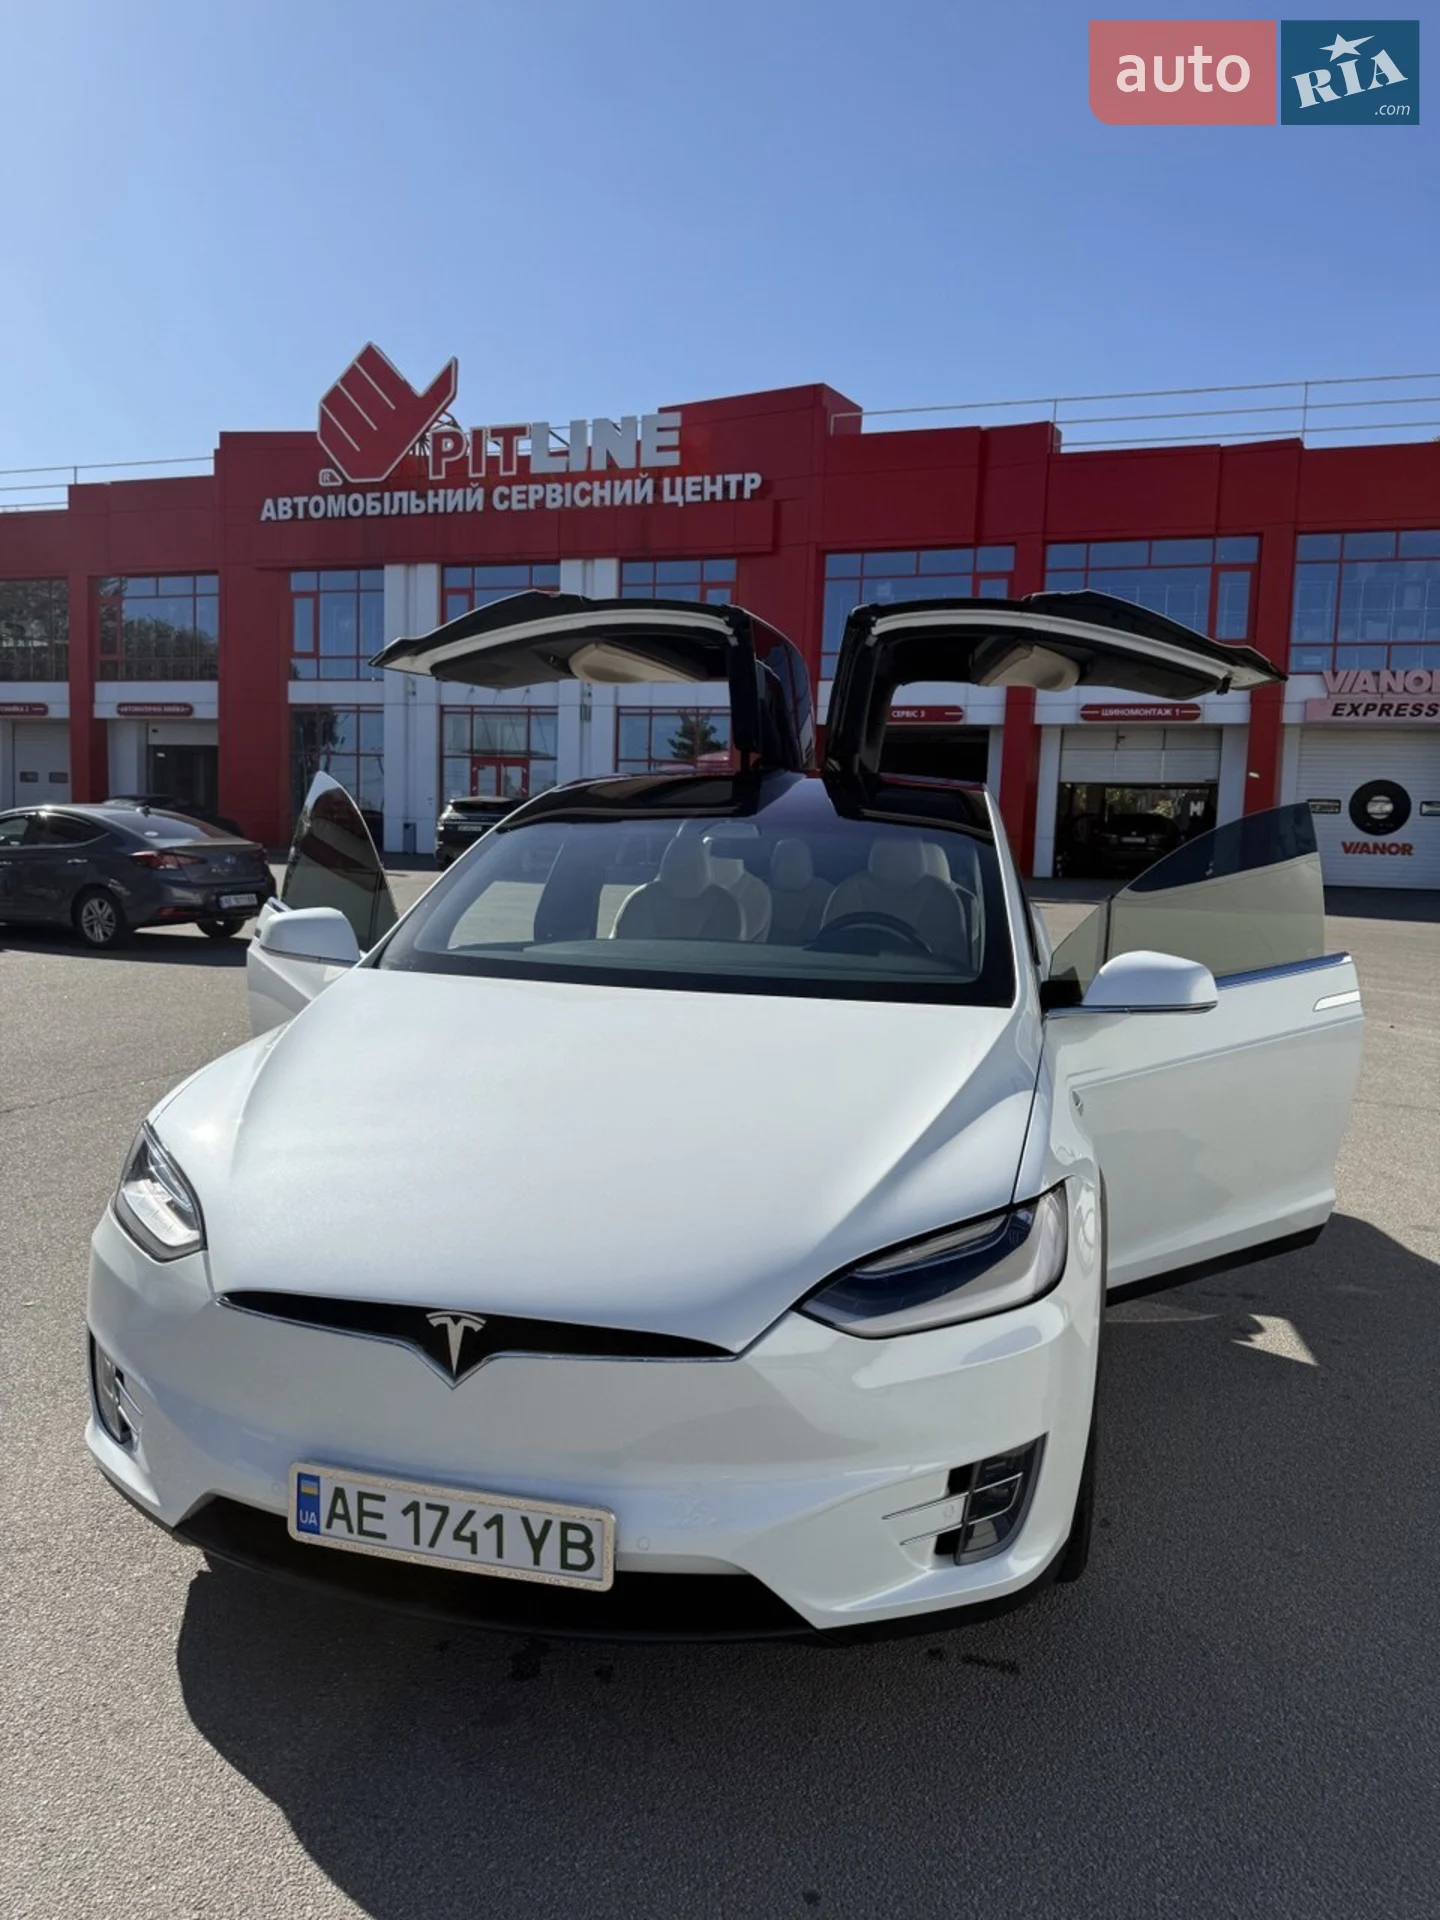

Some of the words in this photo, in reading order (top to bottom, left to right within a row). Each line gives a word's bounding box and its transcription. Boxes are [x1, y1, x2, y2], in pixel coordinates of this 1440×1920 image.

[428, 411, 682, 480] PITLINE
[259, 482, 485, 522] АВТОМОБІЛЬНИЙ
[492, 472, 654, 511] СЕРВІСНИЙ
[662, 472, 763, 508] ЦЕНТР
[1101, 707, 1173, 718] ШИНОМОНТАЖ
[1331, 702, 1440, 718] EXPRESS
[299, 1508, 318, 1527] UA
[325, 1485, 388, 1541] AE
[400, 1499, 504, 1560] 1741
[519, 1515, 596, 1573] YB
